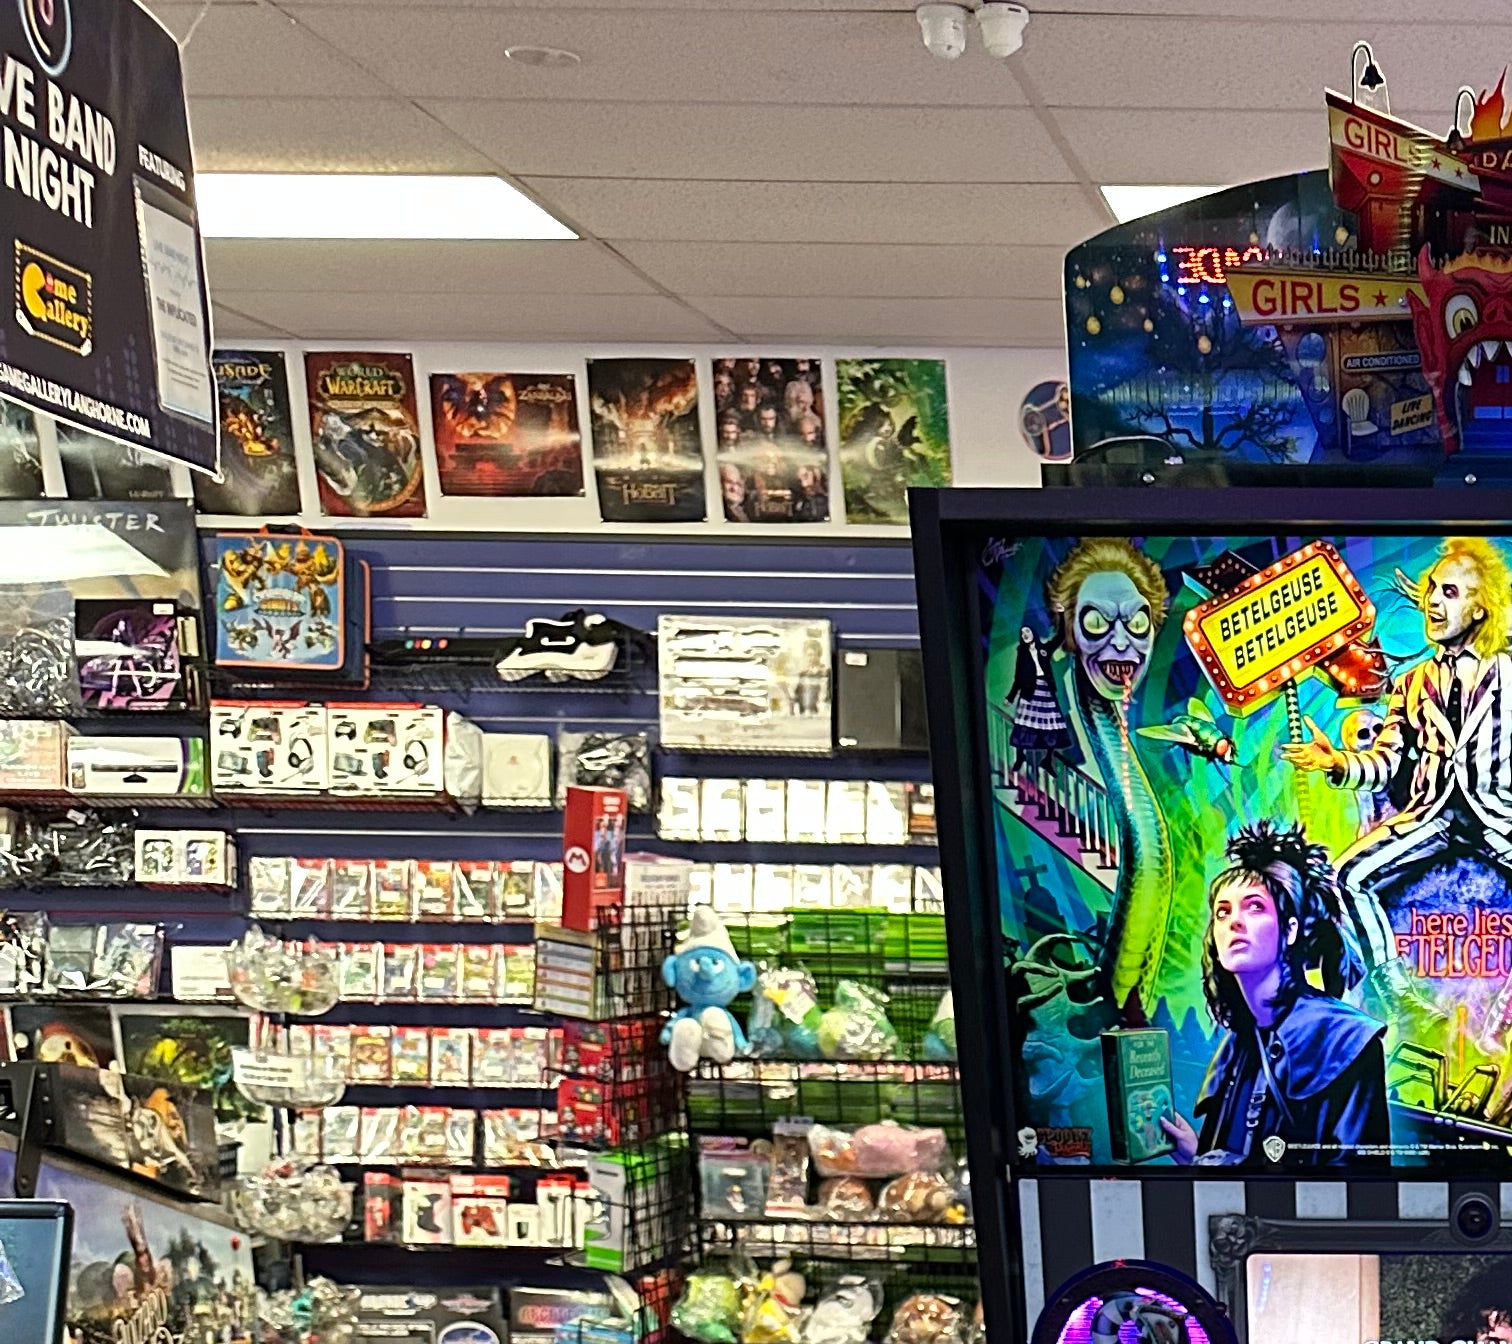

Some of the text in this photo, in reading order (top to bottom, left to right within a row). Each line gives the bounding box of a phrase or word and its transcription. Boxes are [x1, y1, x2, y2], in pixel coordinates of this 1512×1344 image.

[47, 79, 116, 177] BAND
[3, 126, 94, 228] NIGHT
[138, 145, 186, 191] FEATURING
[1252, 279, 1361, 317] GIRLS
[1346, 354, 1421, 369] AIR CONDITIONED
[324, 374, 394, 396] WARCRAFT
[1392, 411, 1433, 430] DANCING
[1400, 399, 1424, 417] LIVE
[1219, 566, 1324, 642] BETELGEUSE
[1233, 591, 1339, 670] BETELGEUSE
[1411, 906, 1468, 936] here
[1129, 1065, 1165, 1079] Deceased
